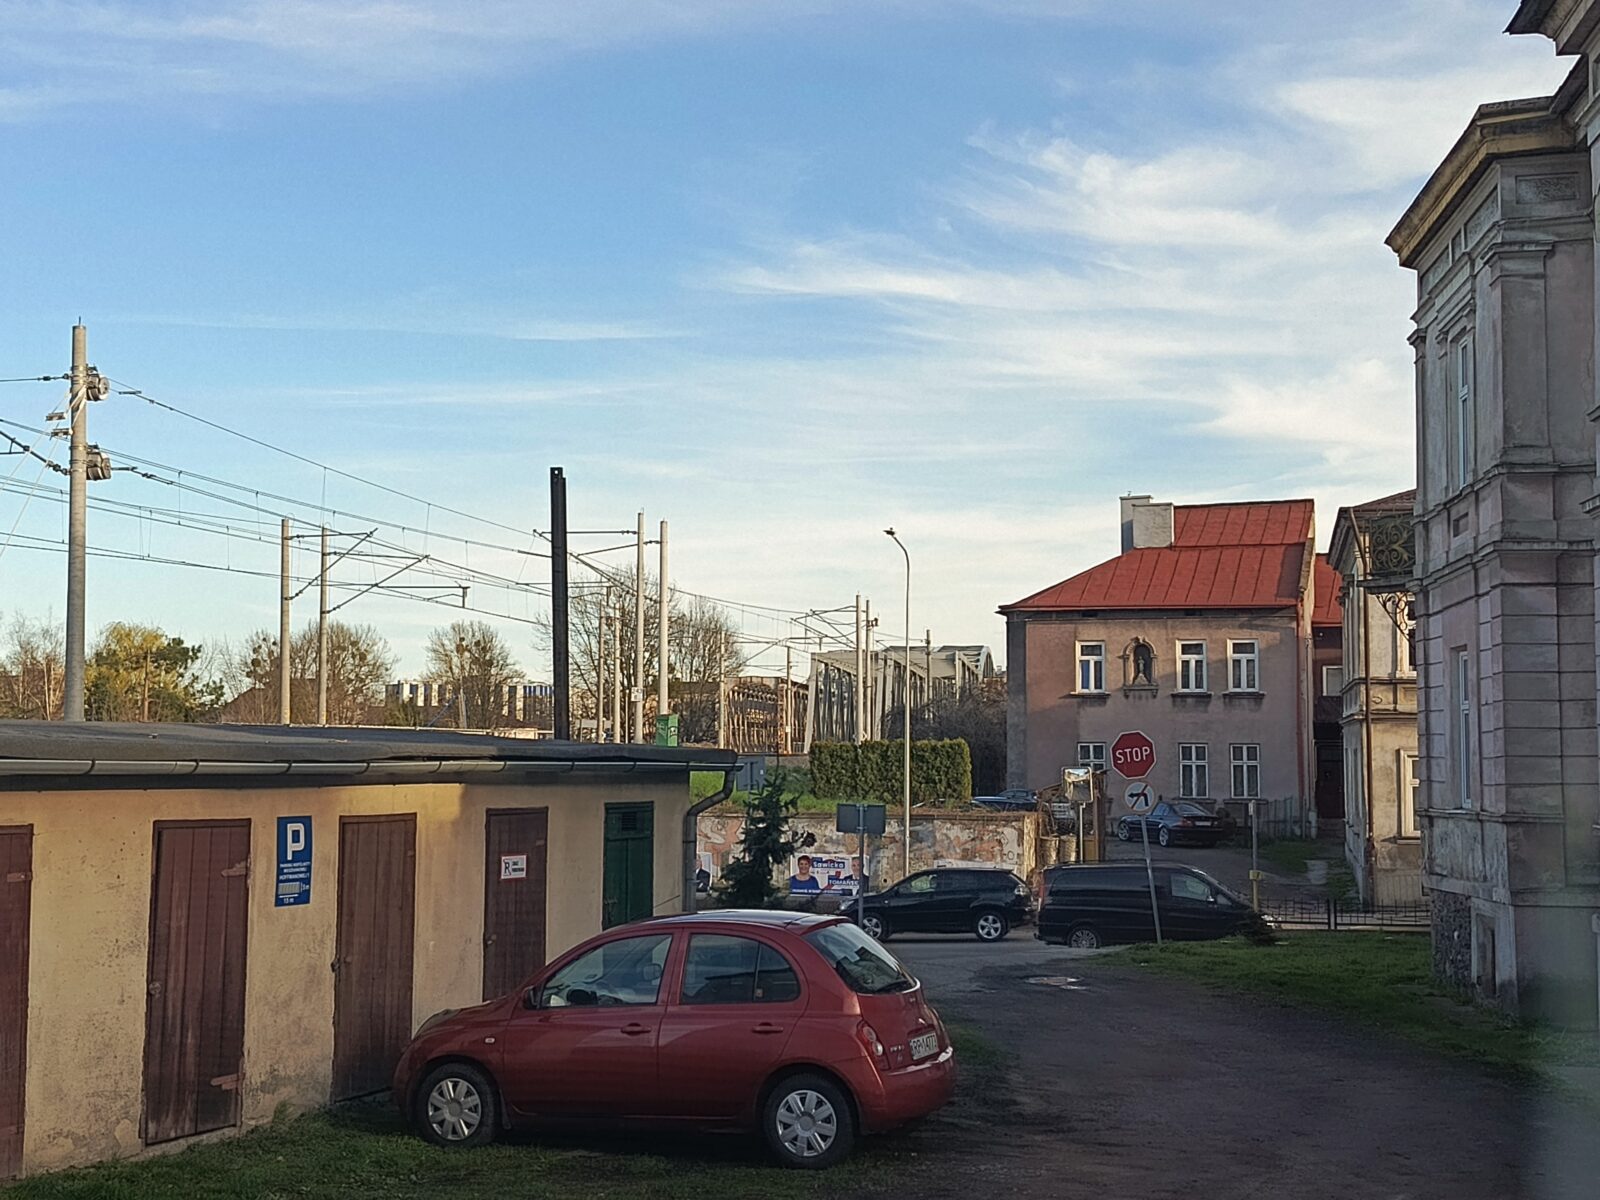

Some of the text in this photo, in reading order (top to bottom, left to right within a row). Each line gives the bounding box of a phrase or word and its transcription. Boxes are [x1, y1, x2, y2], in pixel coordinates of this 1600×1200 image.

[1115, 746, 1151, 764] STOP
[287, 822, 305, 861] P
[828, 878, 861, 886] TOMAŃSK
